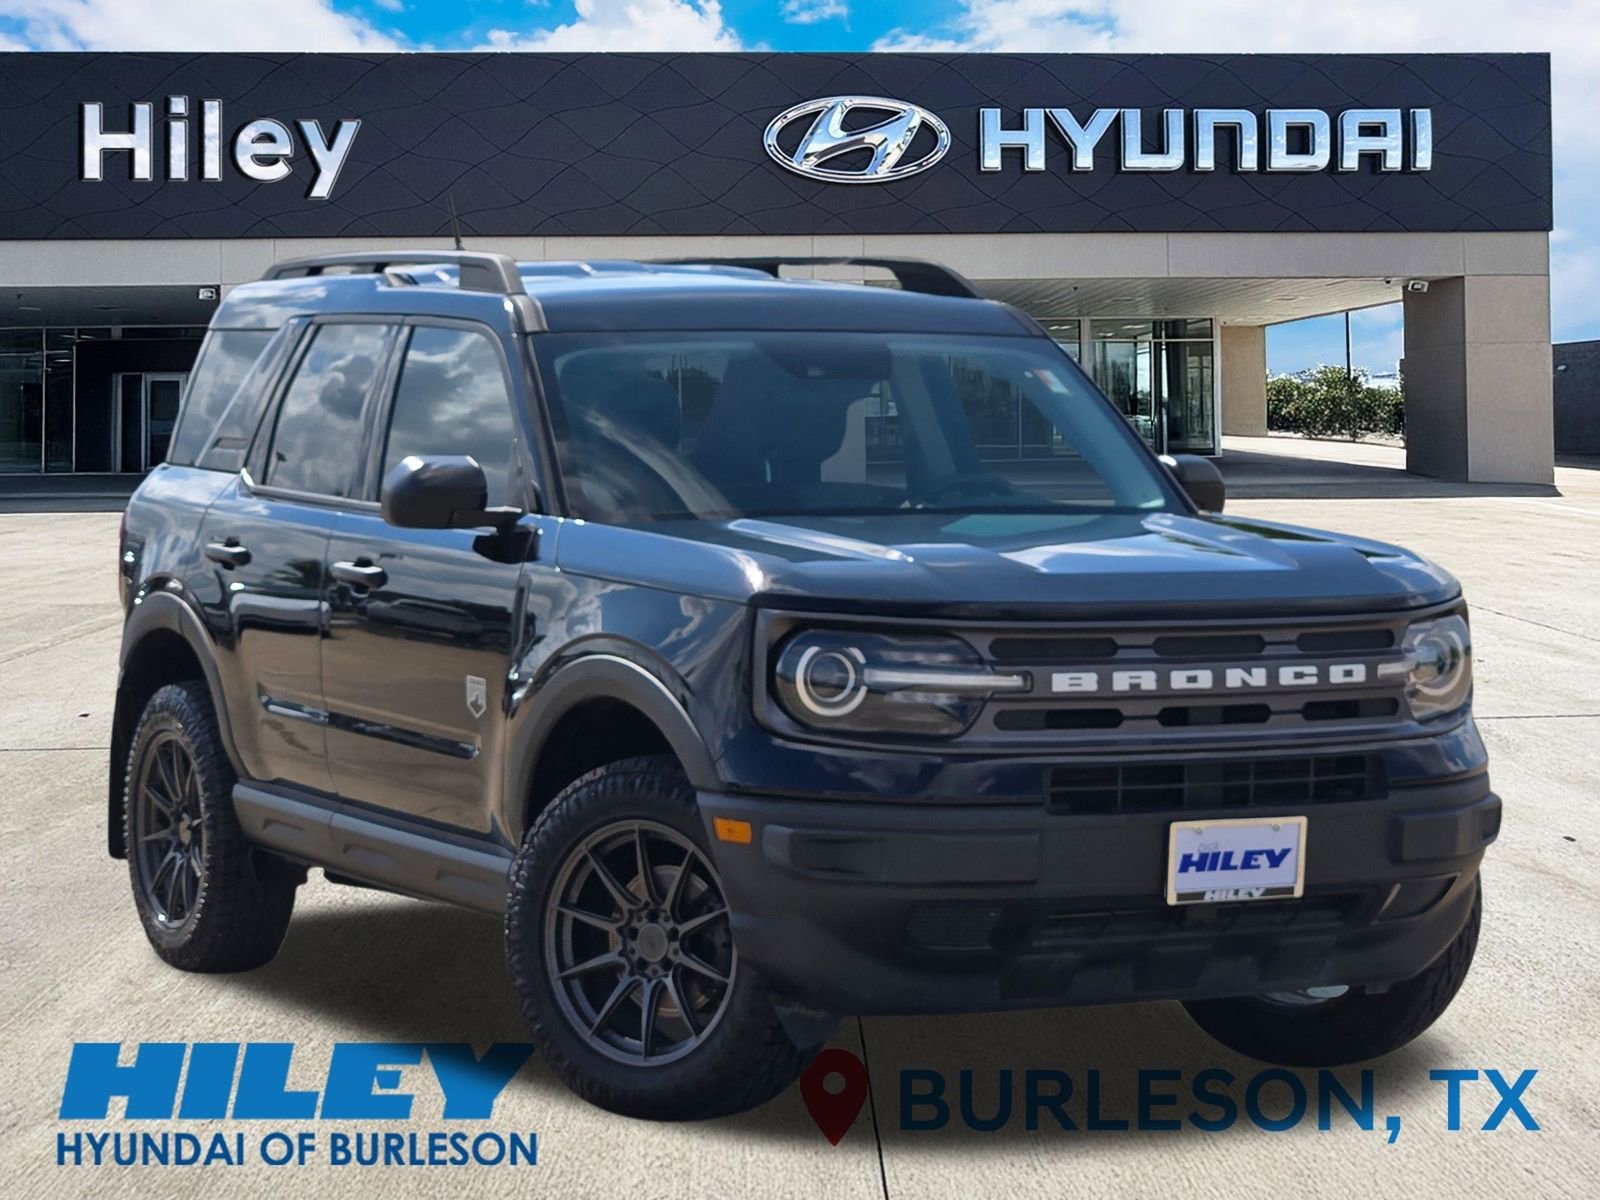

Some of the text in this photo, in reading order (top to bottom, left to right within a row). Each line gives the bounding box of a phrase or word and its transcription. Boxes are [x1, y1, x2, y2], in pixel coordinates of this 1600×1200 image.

[80, 95, 361, 199] Hiley
[978, 106, 1435, 172] HYUNDAI
[1051, 664, 1366, 692] BRONCO
[1178, 848, 1292, 873] HILEY
[1204, 887, 1267, 901] HILEY
